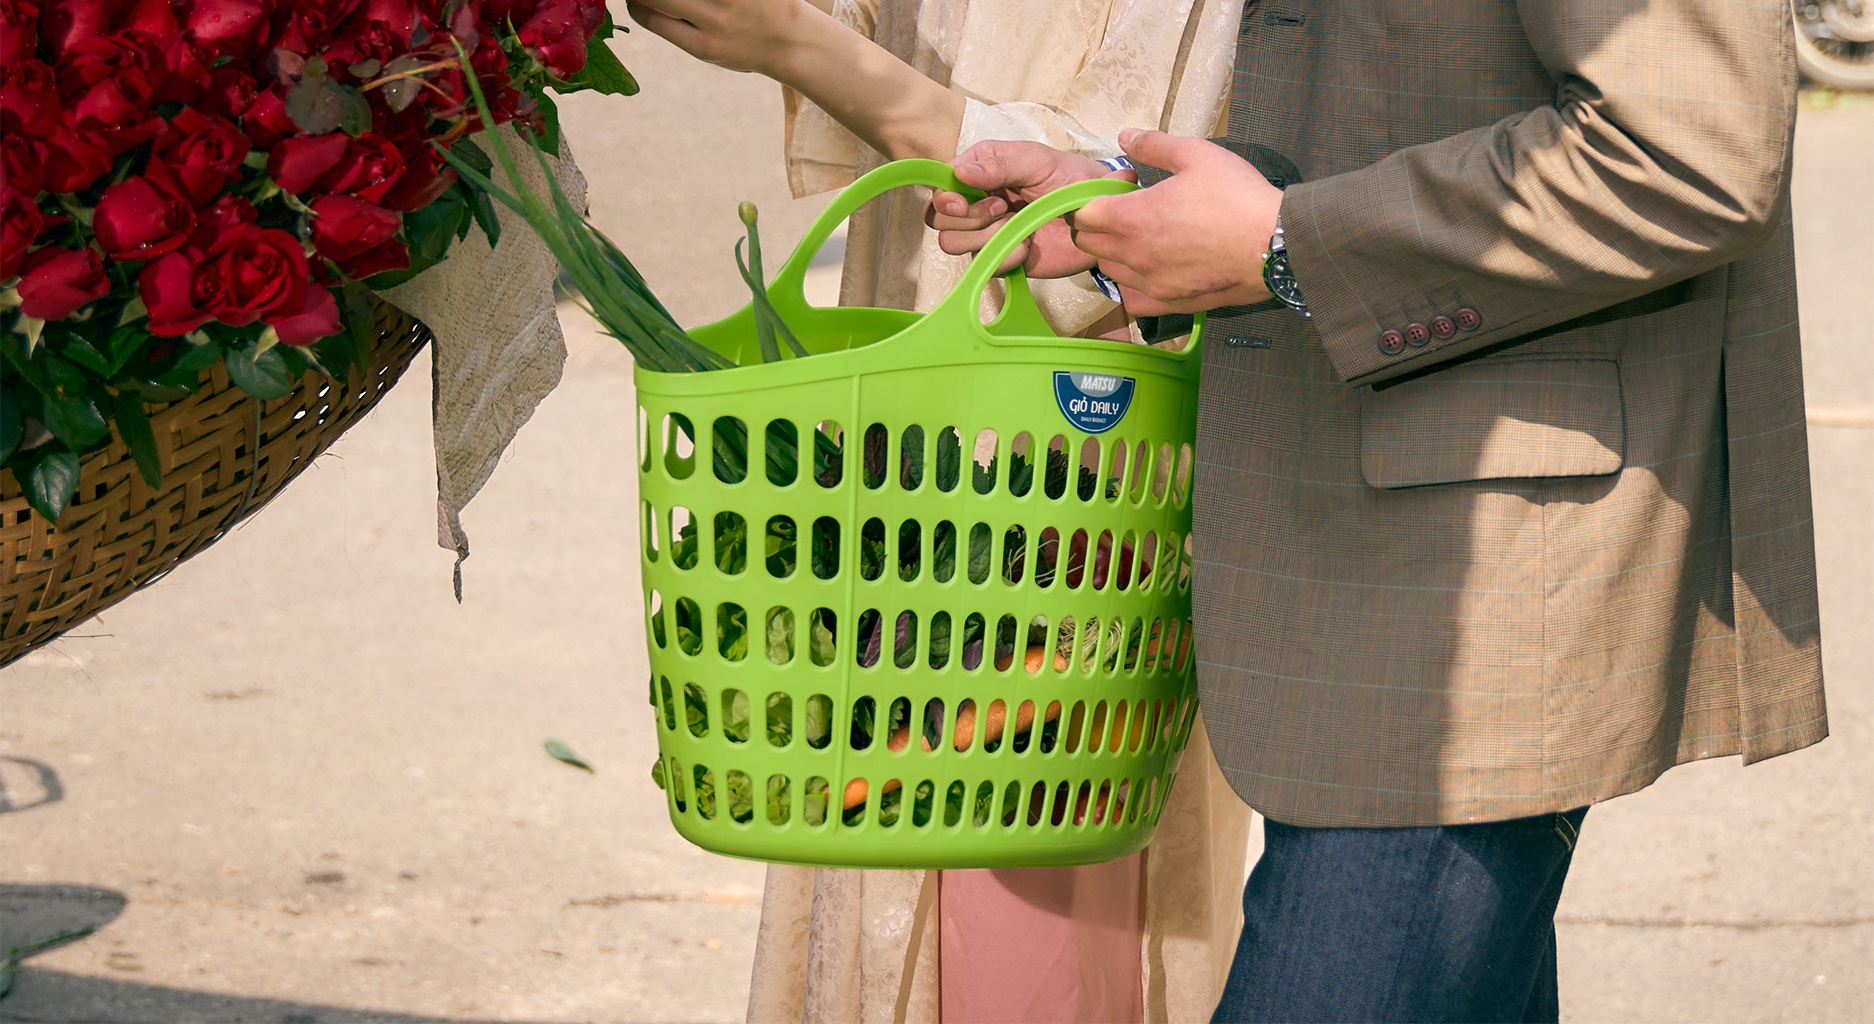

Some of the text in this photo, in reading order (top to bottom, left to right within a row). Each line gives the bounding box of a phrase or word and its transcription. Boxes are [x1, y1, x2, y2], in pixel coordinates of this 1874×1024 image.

[1081, 375, 1116, 392] MATSU
[1069, 396, 1119, 415] GIỎ DAILY
